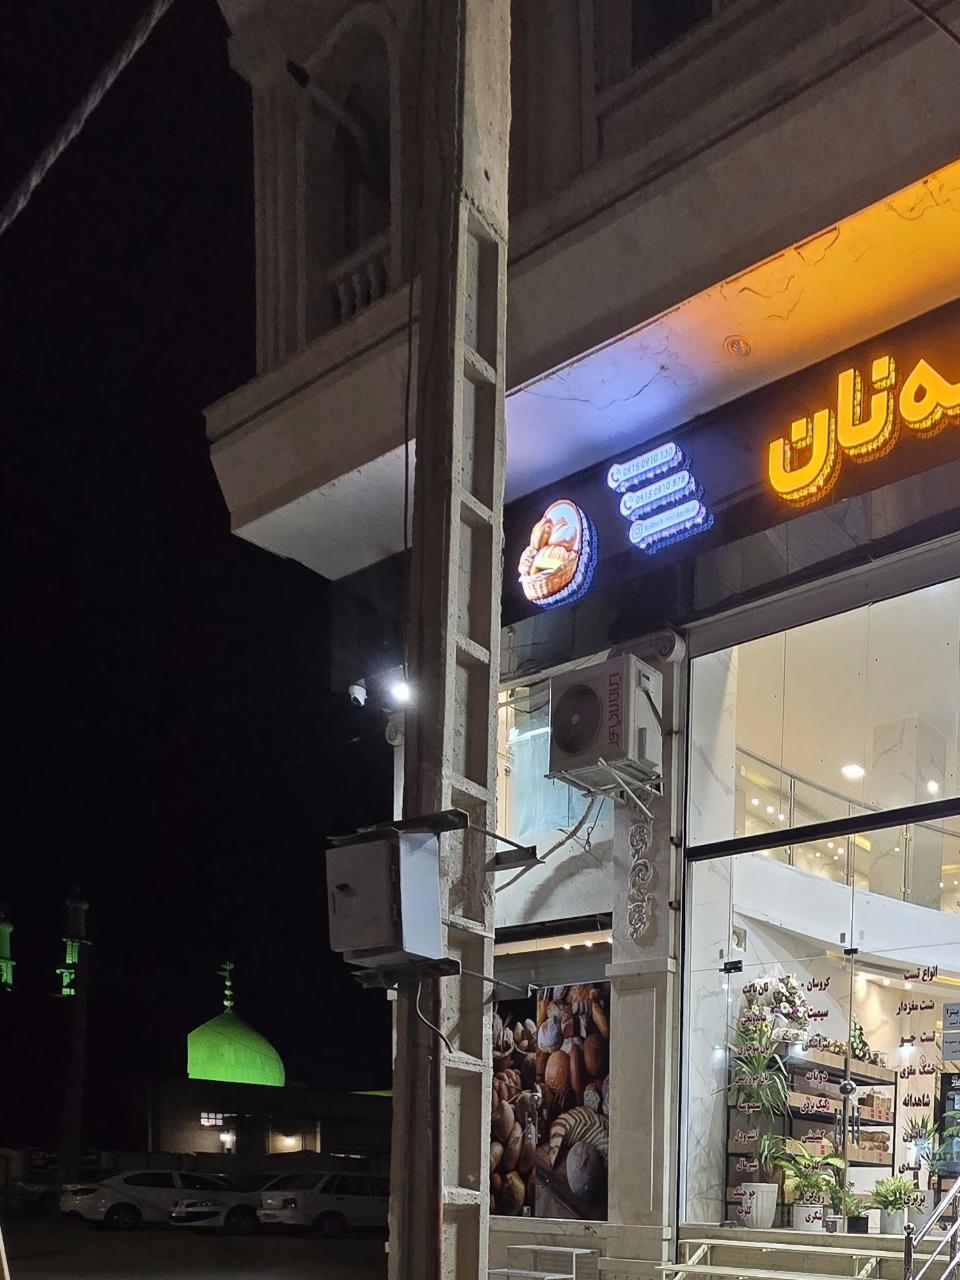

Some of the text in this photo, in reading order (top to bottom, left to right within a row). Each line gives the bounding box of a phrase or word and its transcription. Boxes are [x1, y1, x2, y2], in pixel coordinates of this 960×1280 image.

[766, 353, 896, 500] نان
[903, 965, 938, 981] انواع تست
[806, 977, 831, 992] کروسان
[896, 1000, 935, 1016] تست مغزدار
[898, 1030, 936, 1048] تست جو
[805, 1070, 829, 1084] دونات
[899, 1063, 937, 1080] خشک مغزی
[902, 1092, 931, 1108] شاهدانه
